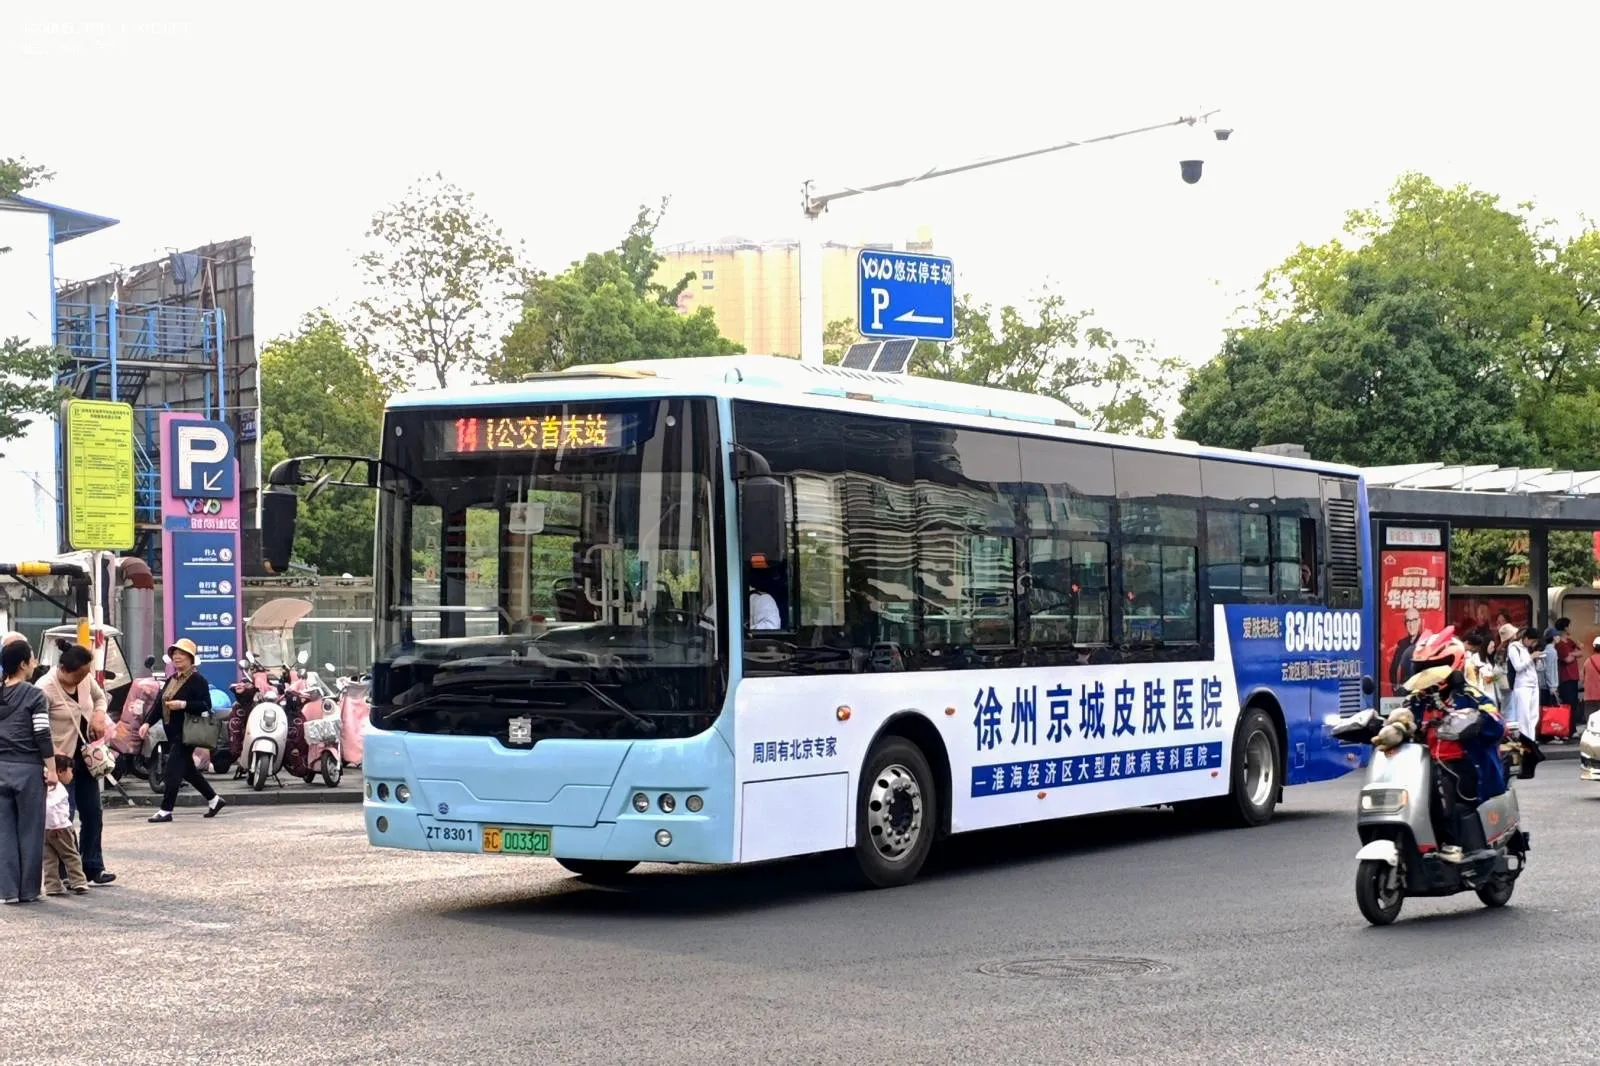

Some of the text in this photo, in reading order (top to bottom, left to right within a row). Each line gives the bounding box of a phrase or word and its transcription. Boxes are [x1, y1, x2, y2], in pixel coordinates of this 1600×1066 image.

[894, 260, 952, 285] 悠沃停车场
[871, 288, 889, 329] P
[179, 427, 229, 489] P
[1285, 611, 1361, 652] 83469999
[973, 676, 1223, 752] 徐州京城皮肤医院
[752, 736, 838, 764] 周周有北京专家
[991, 745, 1209, 792] 淮海经济区大型皮肤病专科医院
[443, 828, 473, 842] 8301
[504, 832, 549, 852] 00332D
